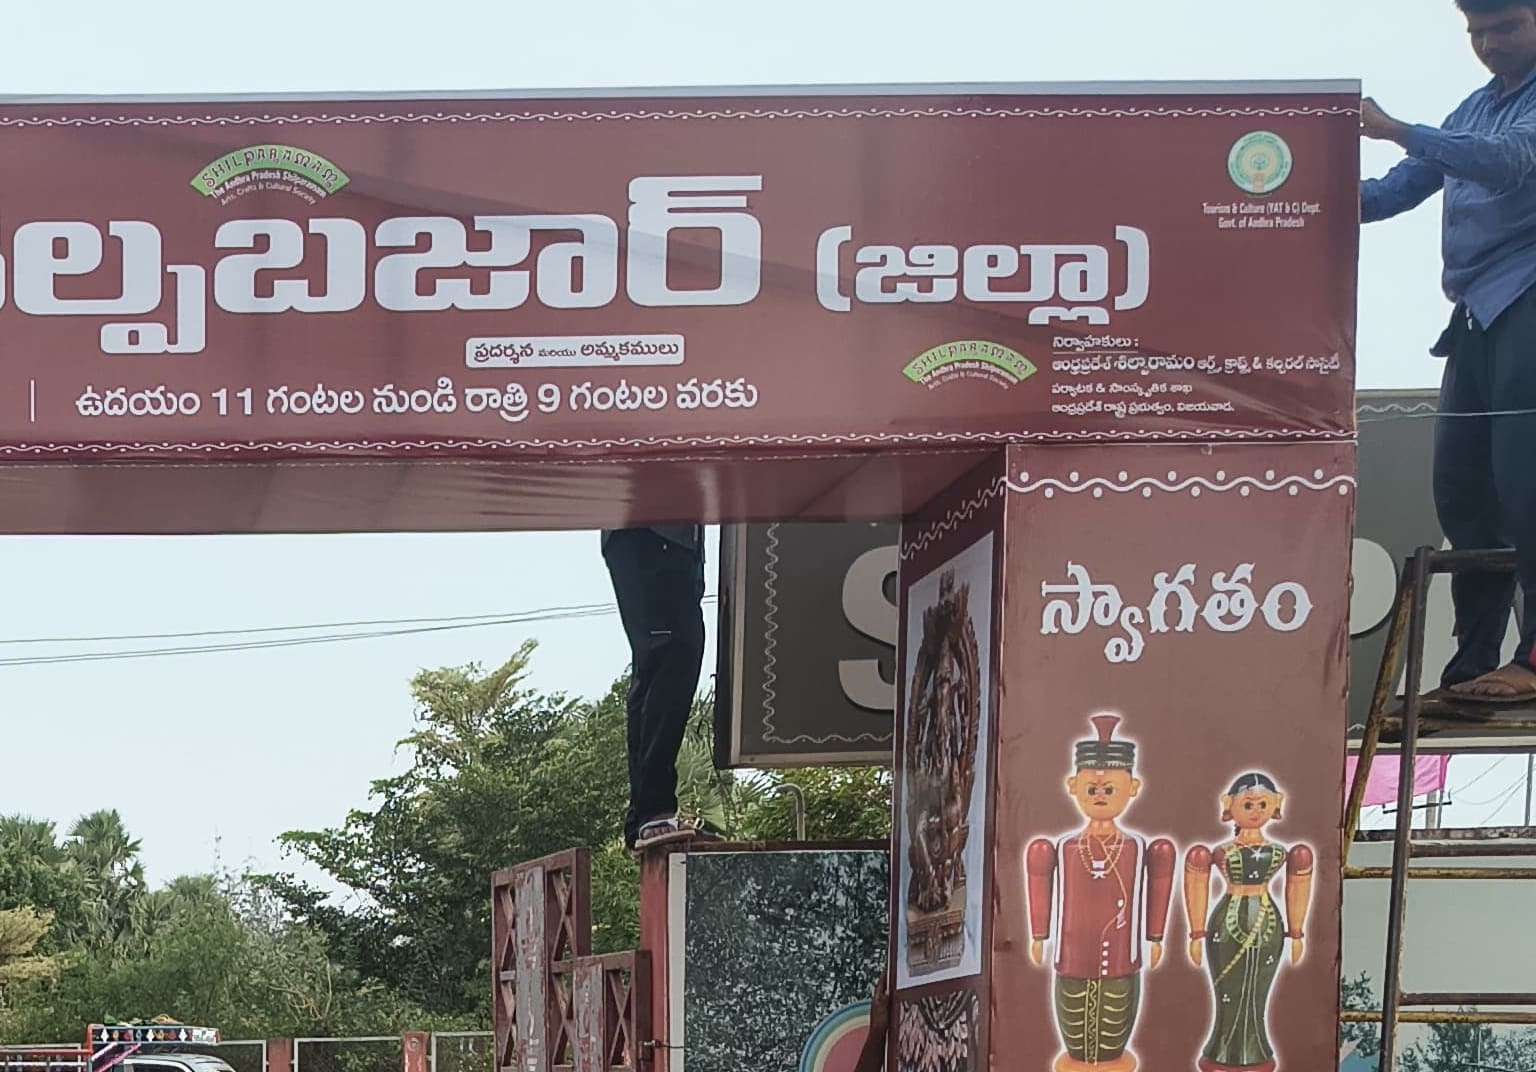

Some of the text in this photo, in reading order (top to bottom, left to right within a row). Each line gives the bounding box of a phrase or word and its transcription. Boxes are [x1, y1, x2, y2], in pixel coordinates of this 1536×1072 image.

[474, 340, 679, 364] ప్రదర్శన మరియు అమ్మకములు
[75, 377, 758, 422] ఉదయం 11 గంటల నుండి రాత్రి 9 గంటల వరకు
[1040, 561, 1313, 663] స్వాగతం
